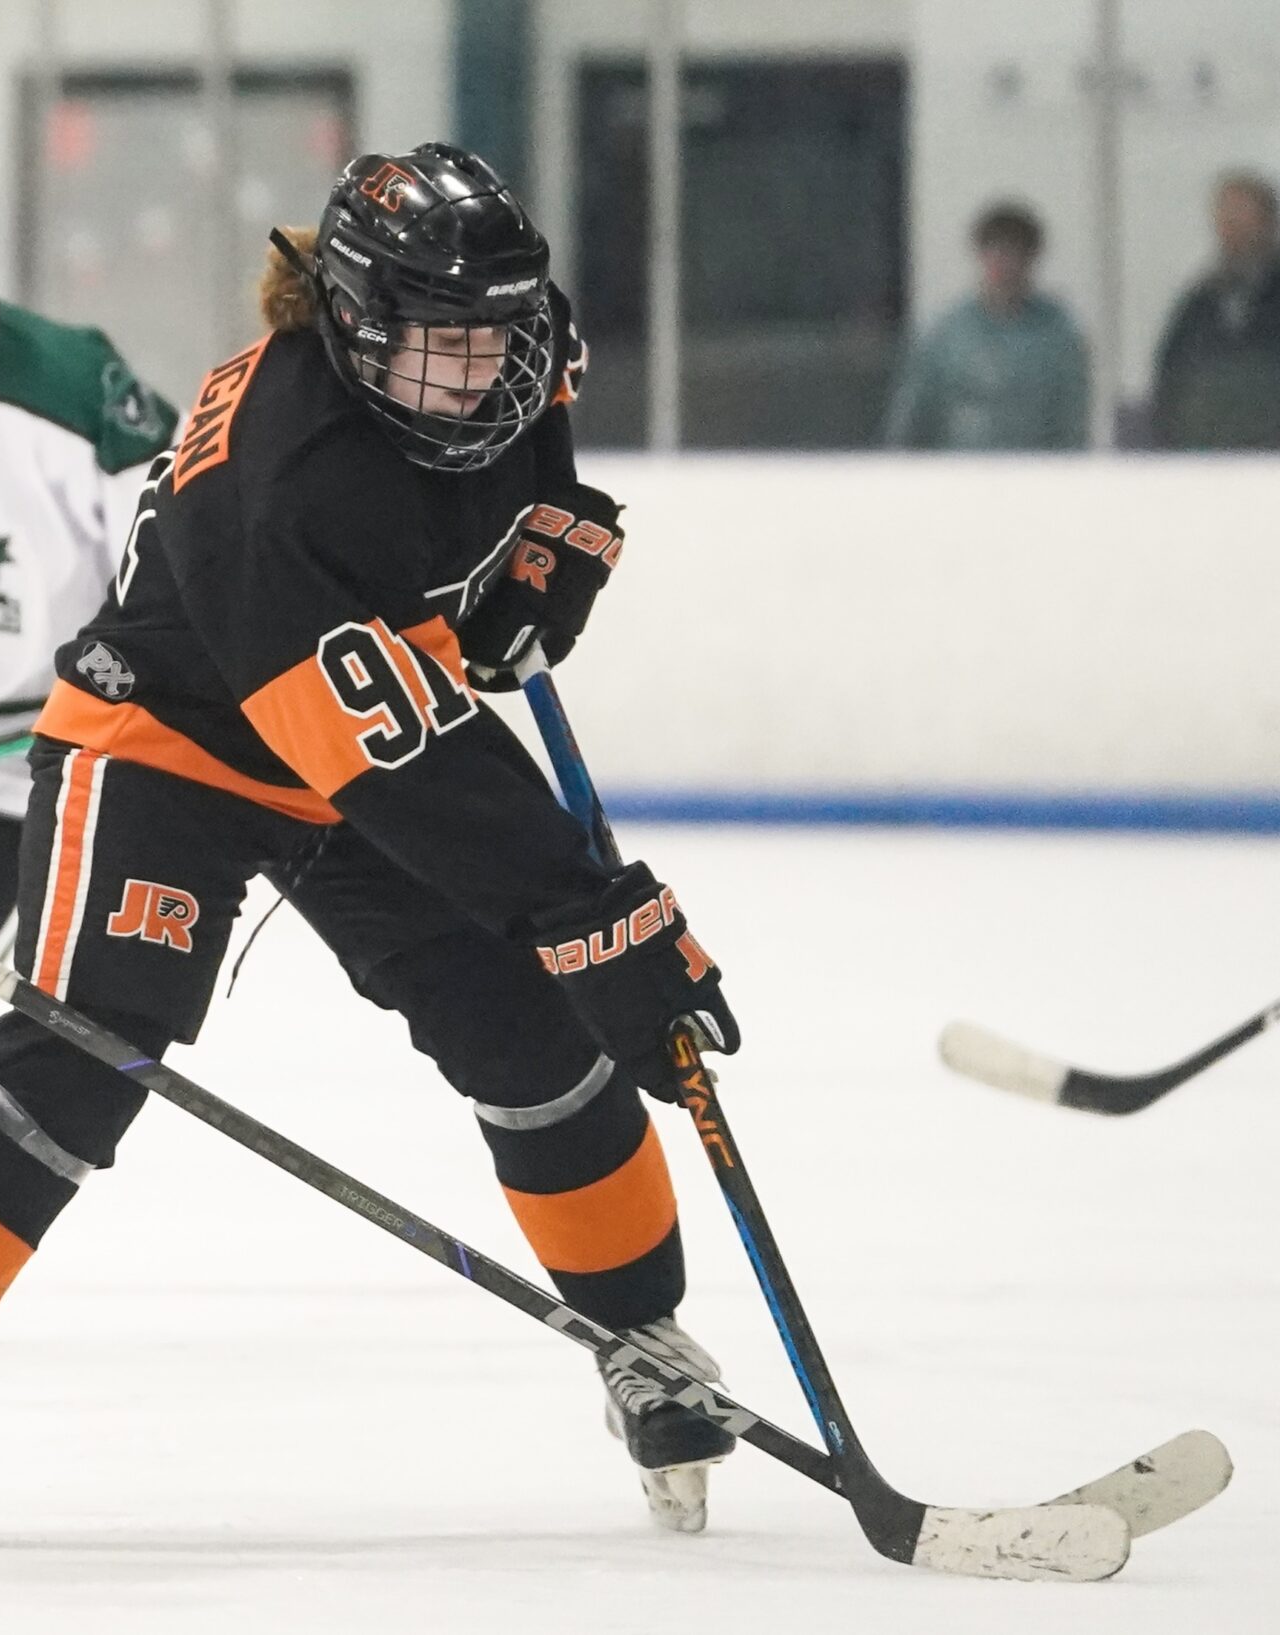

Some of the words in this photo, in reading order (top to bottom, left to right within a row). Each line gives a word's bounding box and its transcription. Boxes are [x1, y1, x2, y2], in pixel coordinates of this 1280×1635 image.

[358, 329, 388, 345] CCM
[316, 616, 480, 770] 91
[106, 878, 200, 953] JR
[674, 1032, 735, 1169] SYNC
[544, 1304, 761, 1437] CCM
